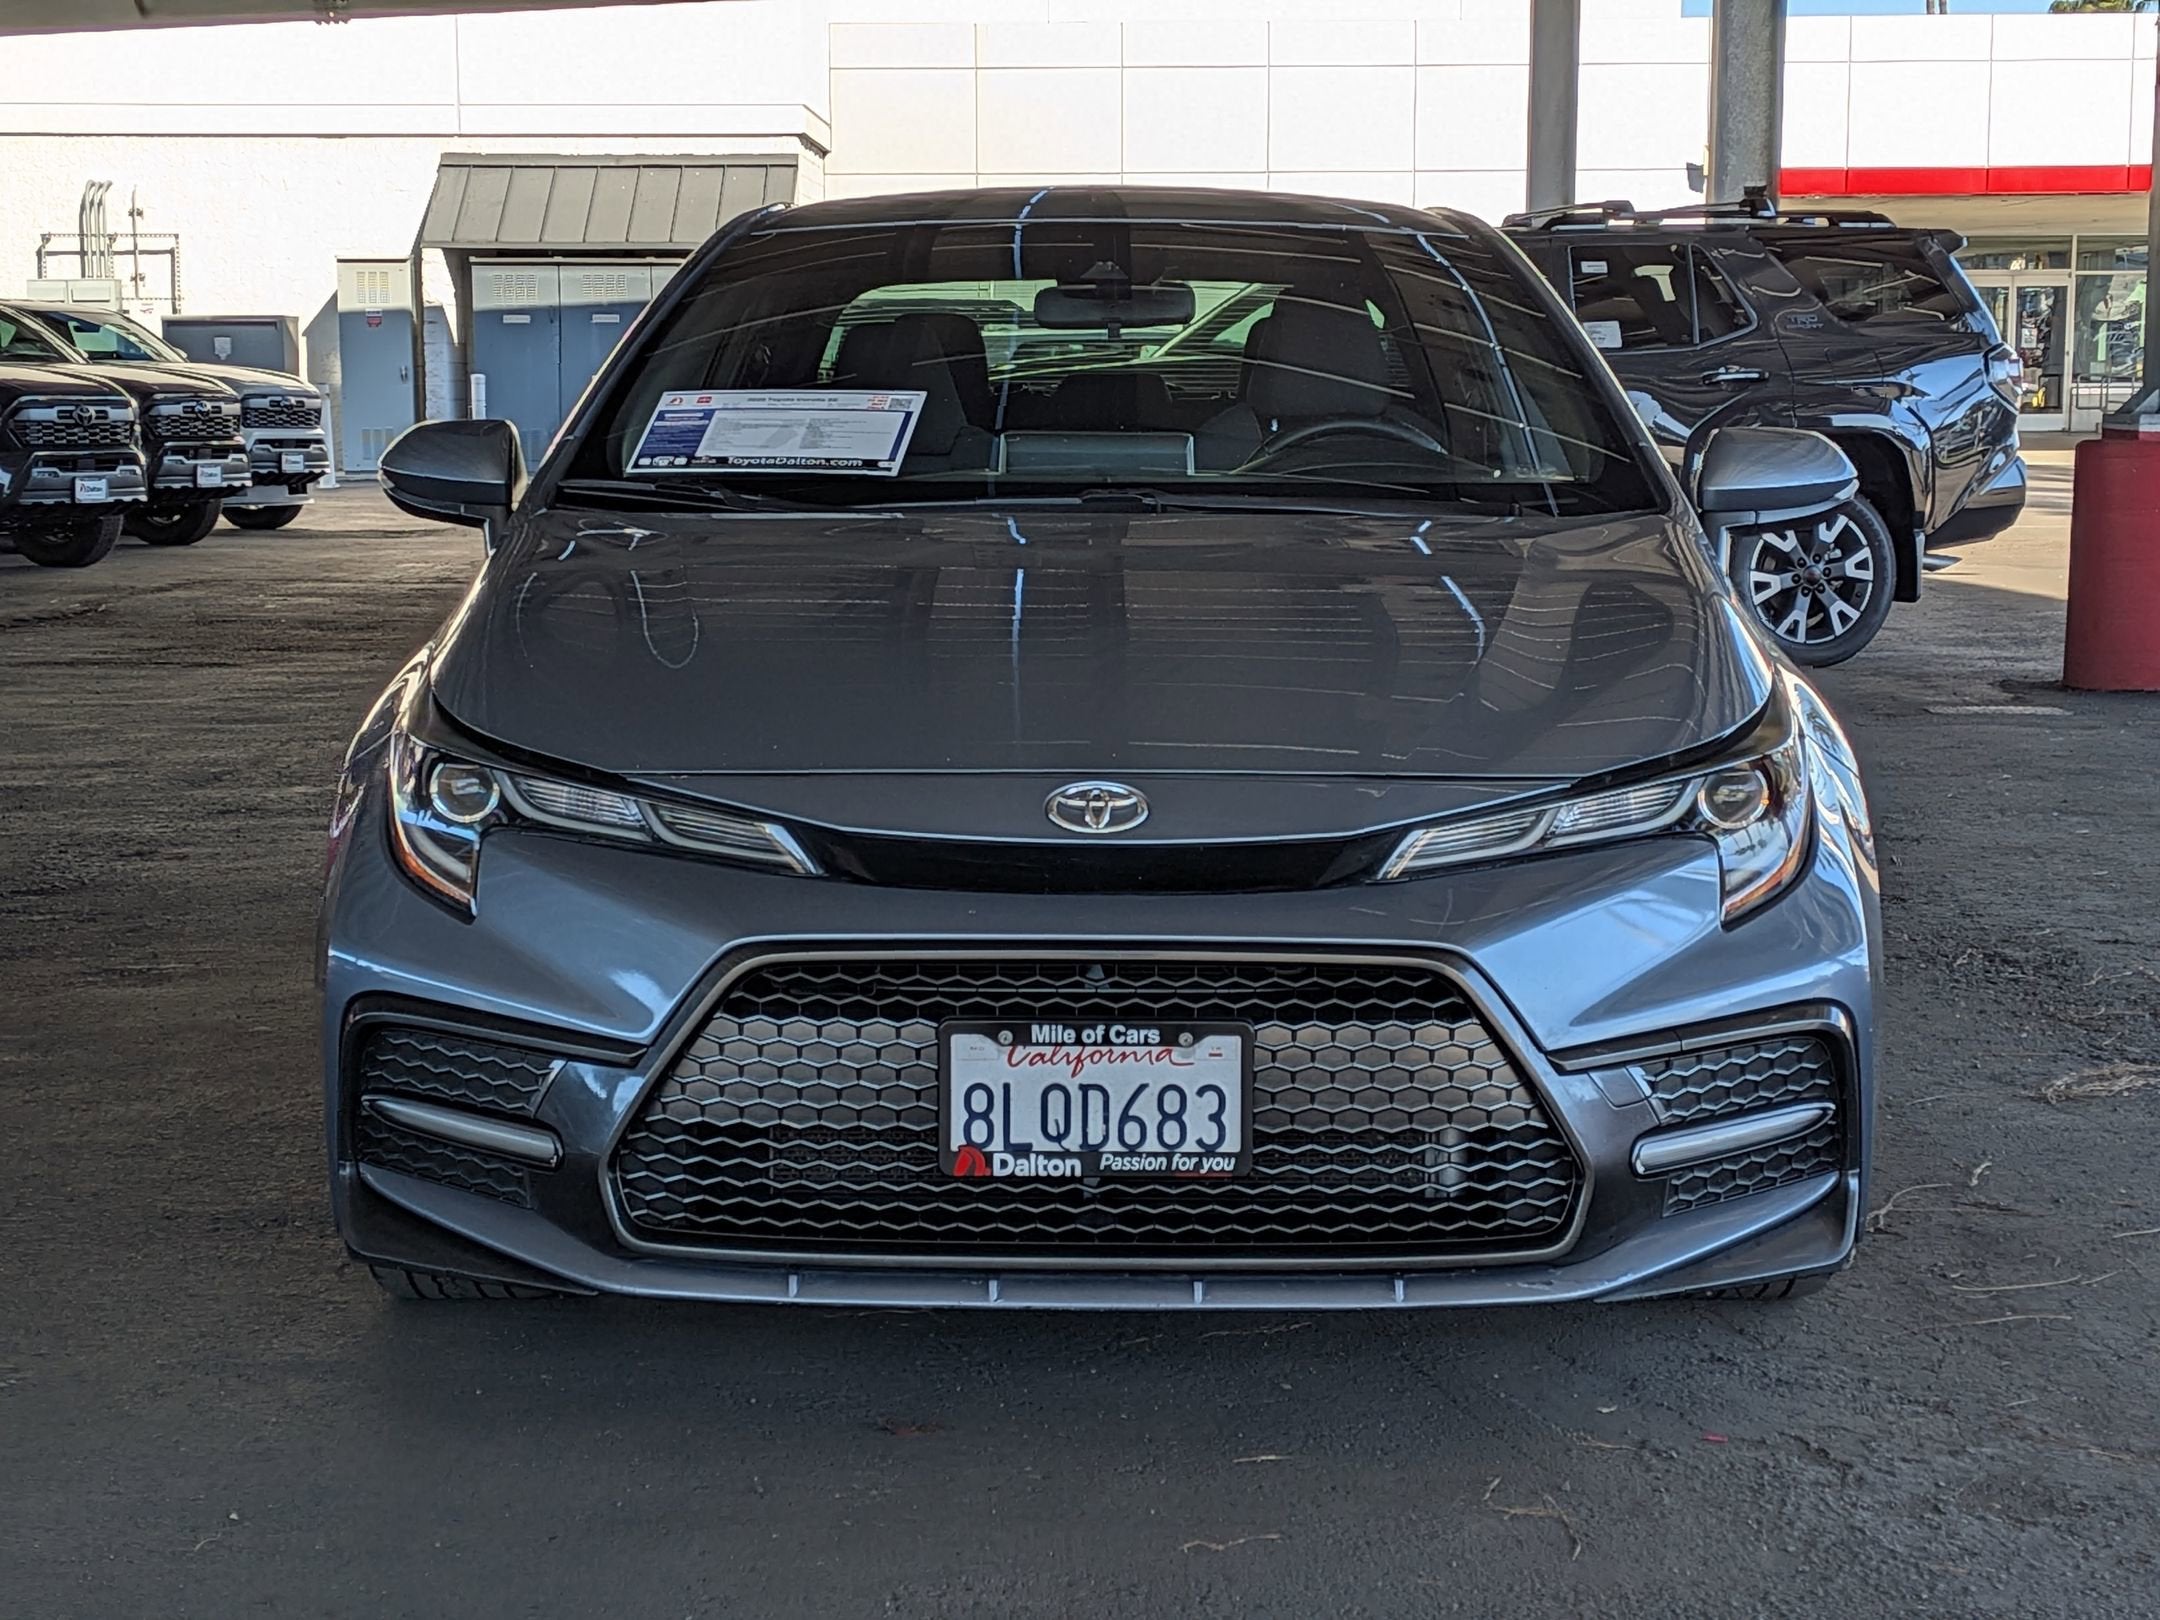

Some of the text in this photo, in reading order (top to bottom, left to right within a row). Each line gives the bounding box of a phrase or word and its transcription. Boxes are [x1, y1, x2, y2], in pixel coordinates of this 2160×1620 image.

[727, 455, 864, 468] ToyotaDalton.com
[1031, 1024, 1161, 1045] Mile of Cars
[1006, 1045, 1195, 1079] California
[963, 1082, 1227, 1152] 8LQD683
[992, 1152, 1082, 1177] Dalton
[1099, 1153, 1236, 1174] Passion for you
